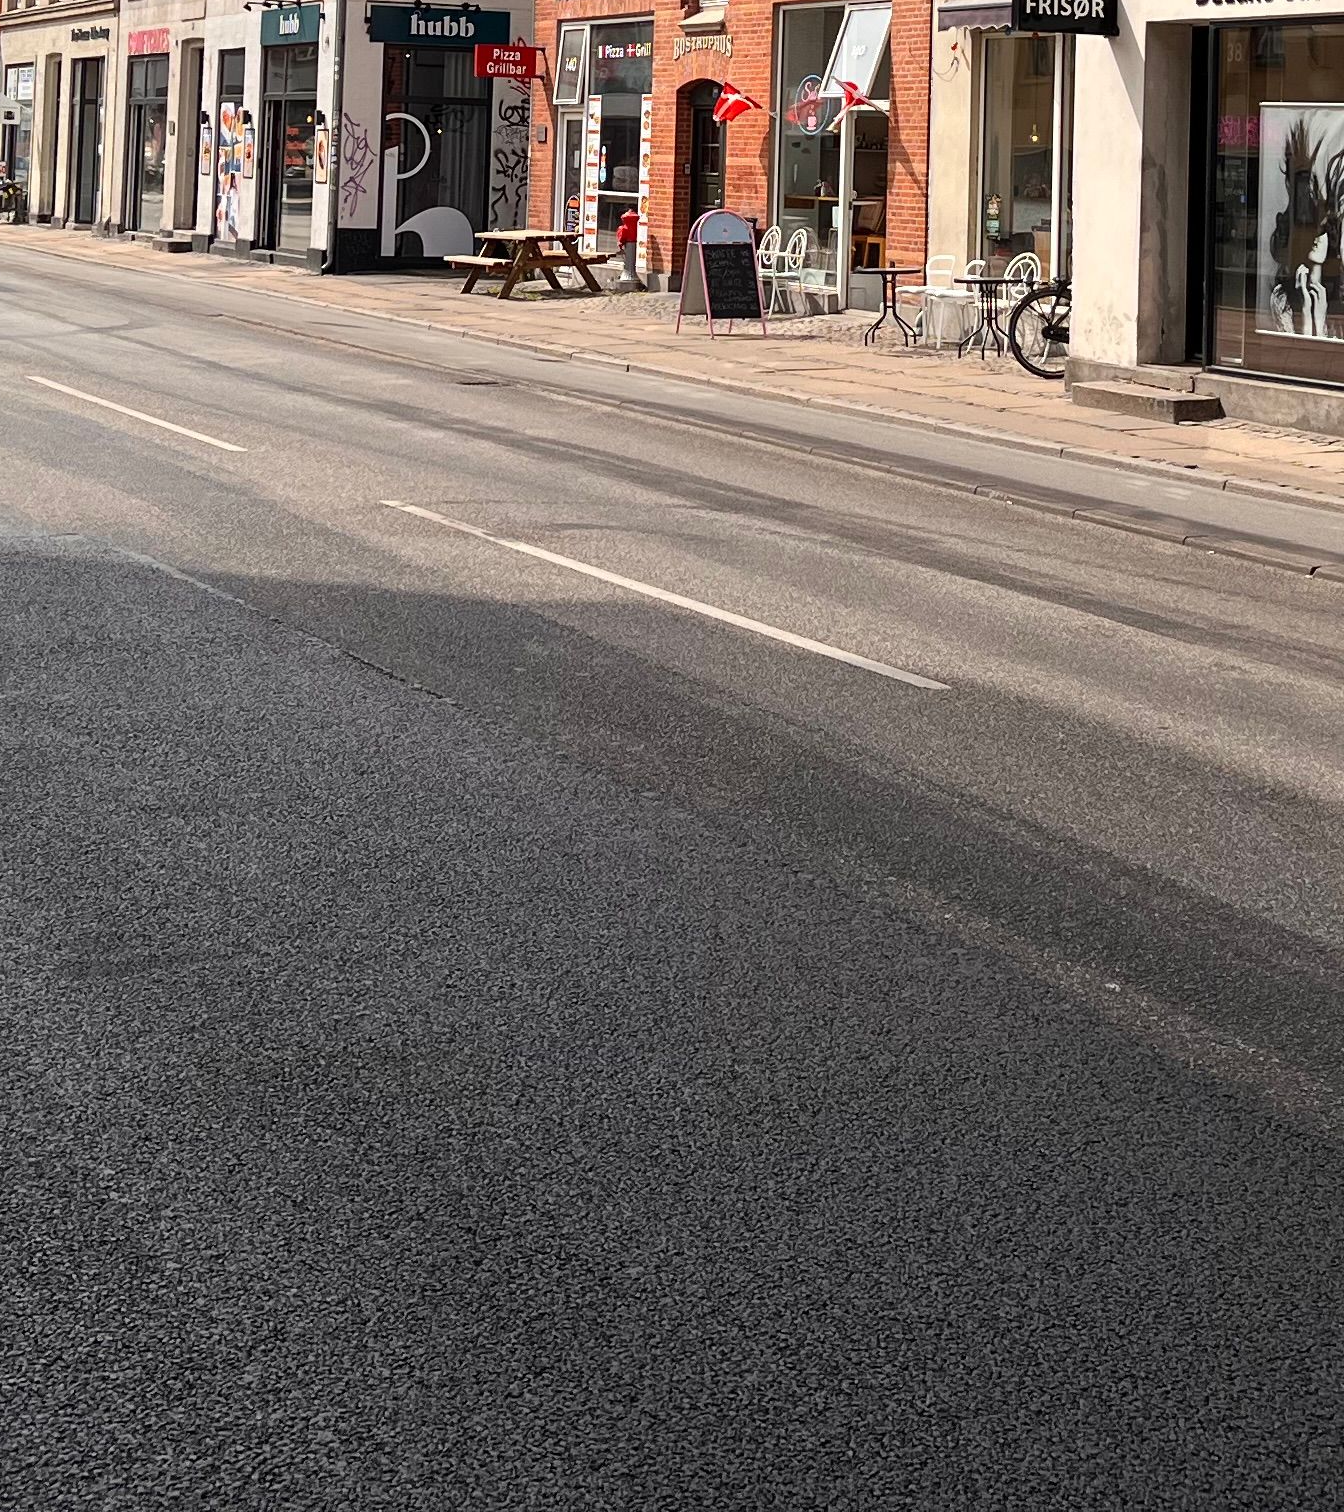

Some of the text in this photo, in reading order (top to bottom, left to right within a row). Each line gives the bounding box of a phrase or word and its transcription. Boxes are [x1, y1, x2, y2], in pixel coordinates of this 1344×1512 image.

[279, 12, 300, 35] hubb
[409, 13, 475, 38] hubb
[492, 48, 521, 61] Pizza
[603, 44, 625, 59] Pizza
[486, 62, 527, 75] Grillbar
